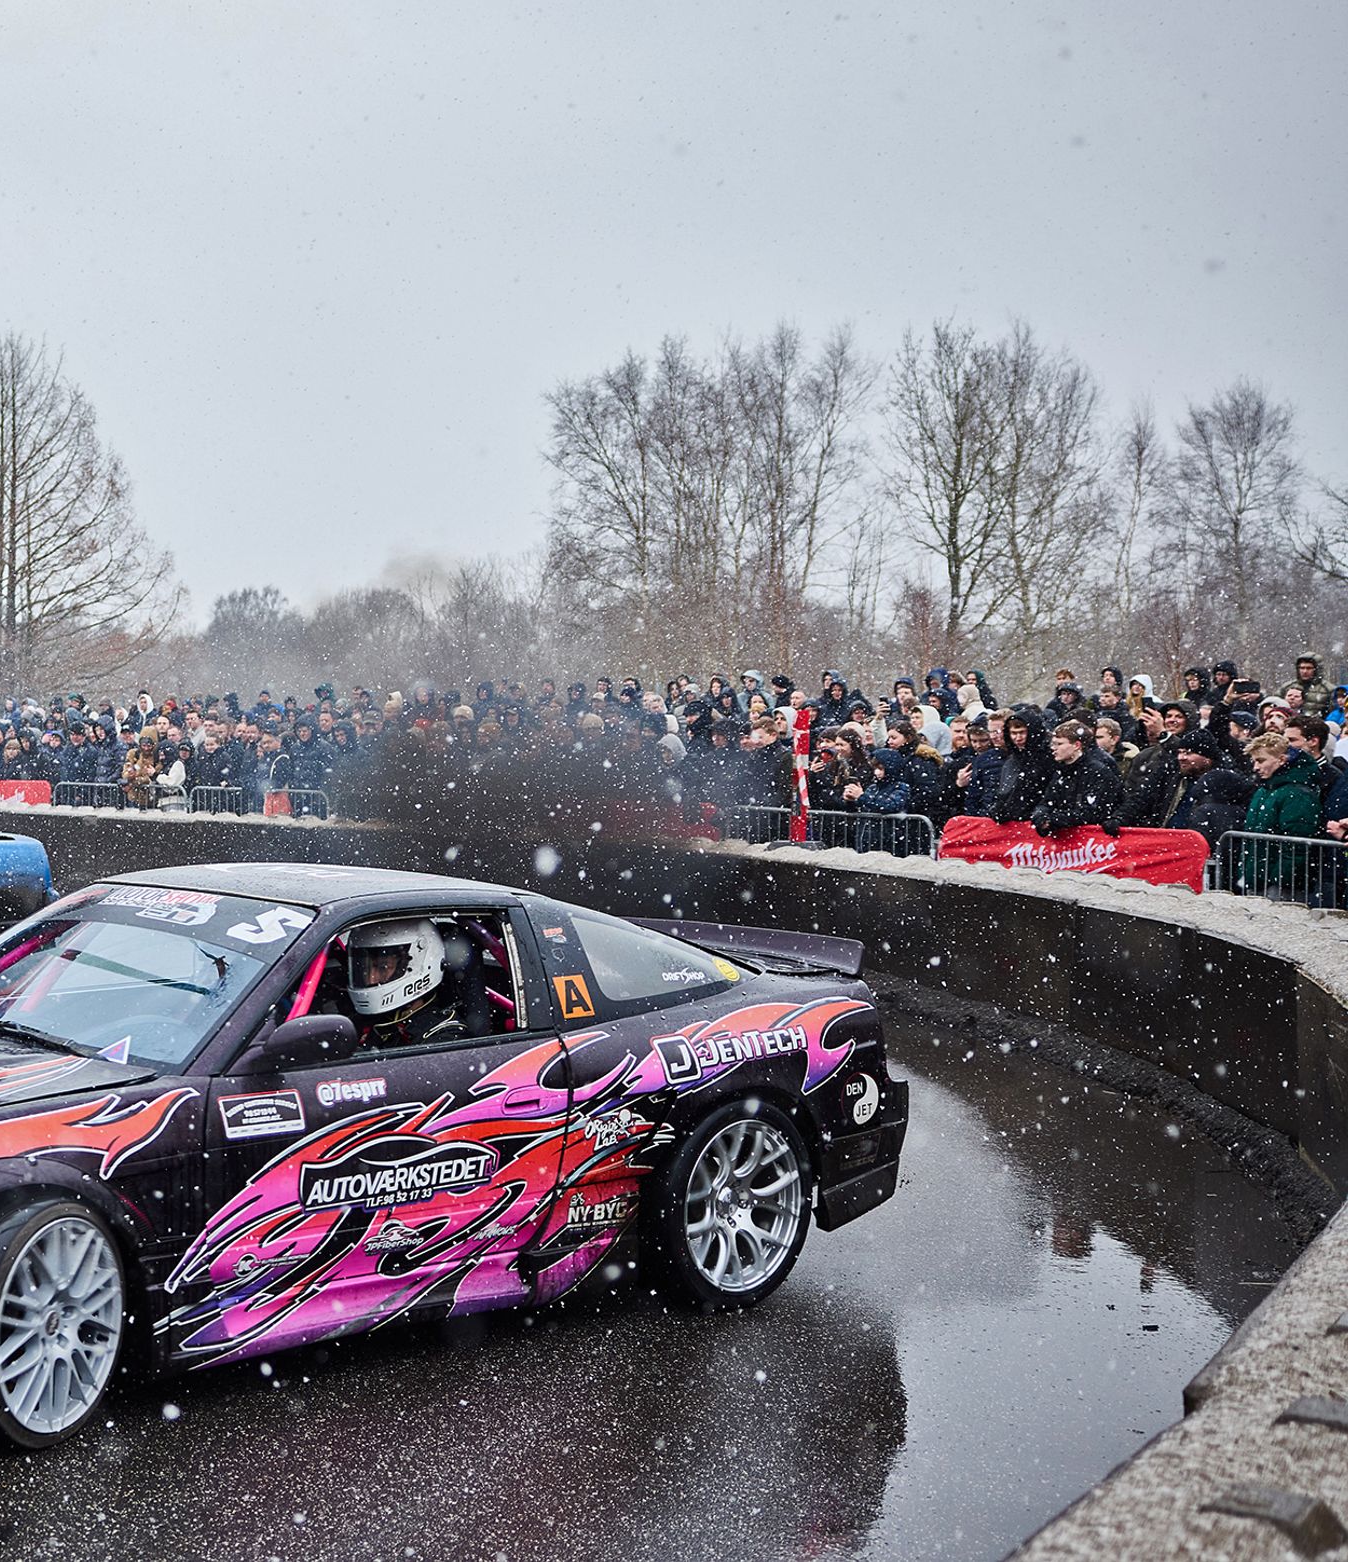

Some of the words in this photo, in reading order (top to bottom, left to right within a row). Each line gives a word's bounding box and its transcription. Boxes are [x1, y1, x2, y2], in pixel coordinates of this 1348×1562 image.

[404, 973, 431, 997] RRS
[564, 979, 592, 1015] A
[700, 1025, 808, 1067] JENTECH
[846, 1081, 864, 1097] DEN
[856, 1102, 873, 1117] JET
[305, 1154, 491, 1206] AUTOVÆRKSTEDET
[409, 1192, 420, 1201] 17
[420, 1187, 433, 1198] 33
